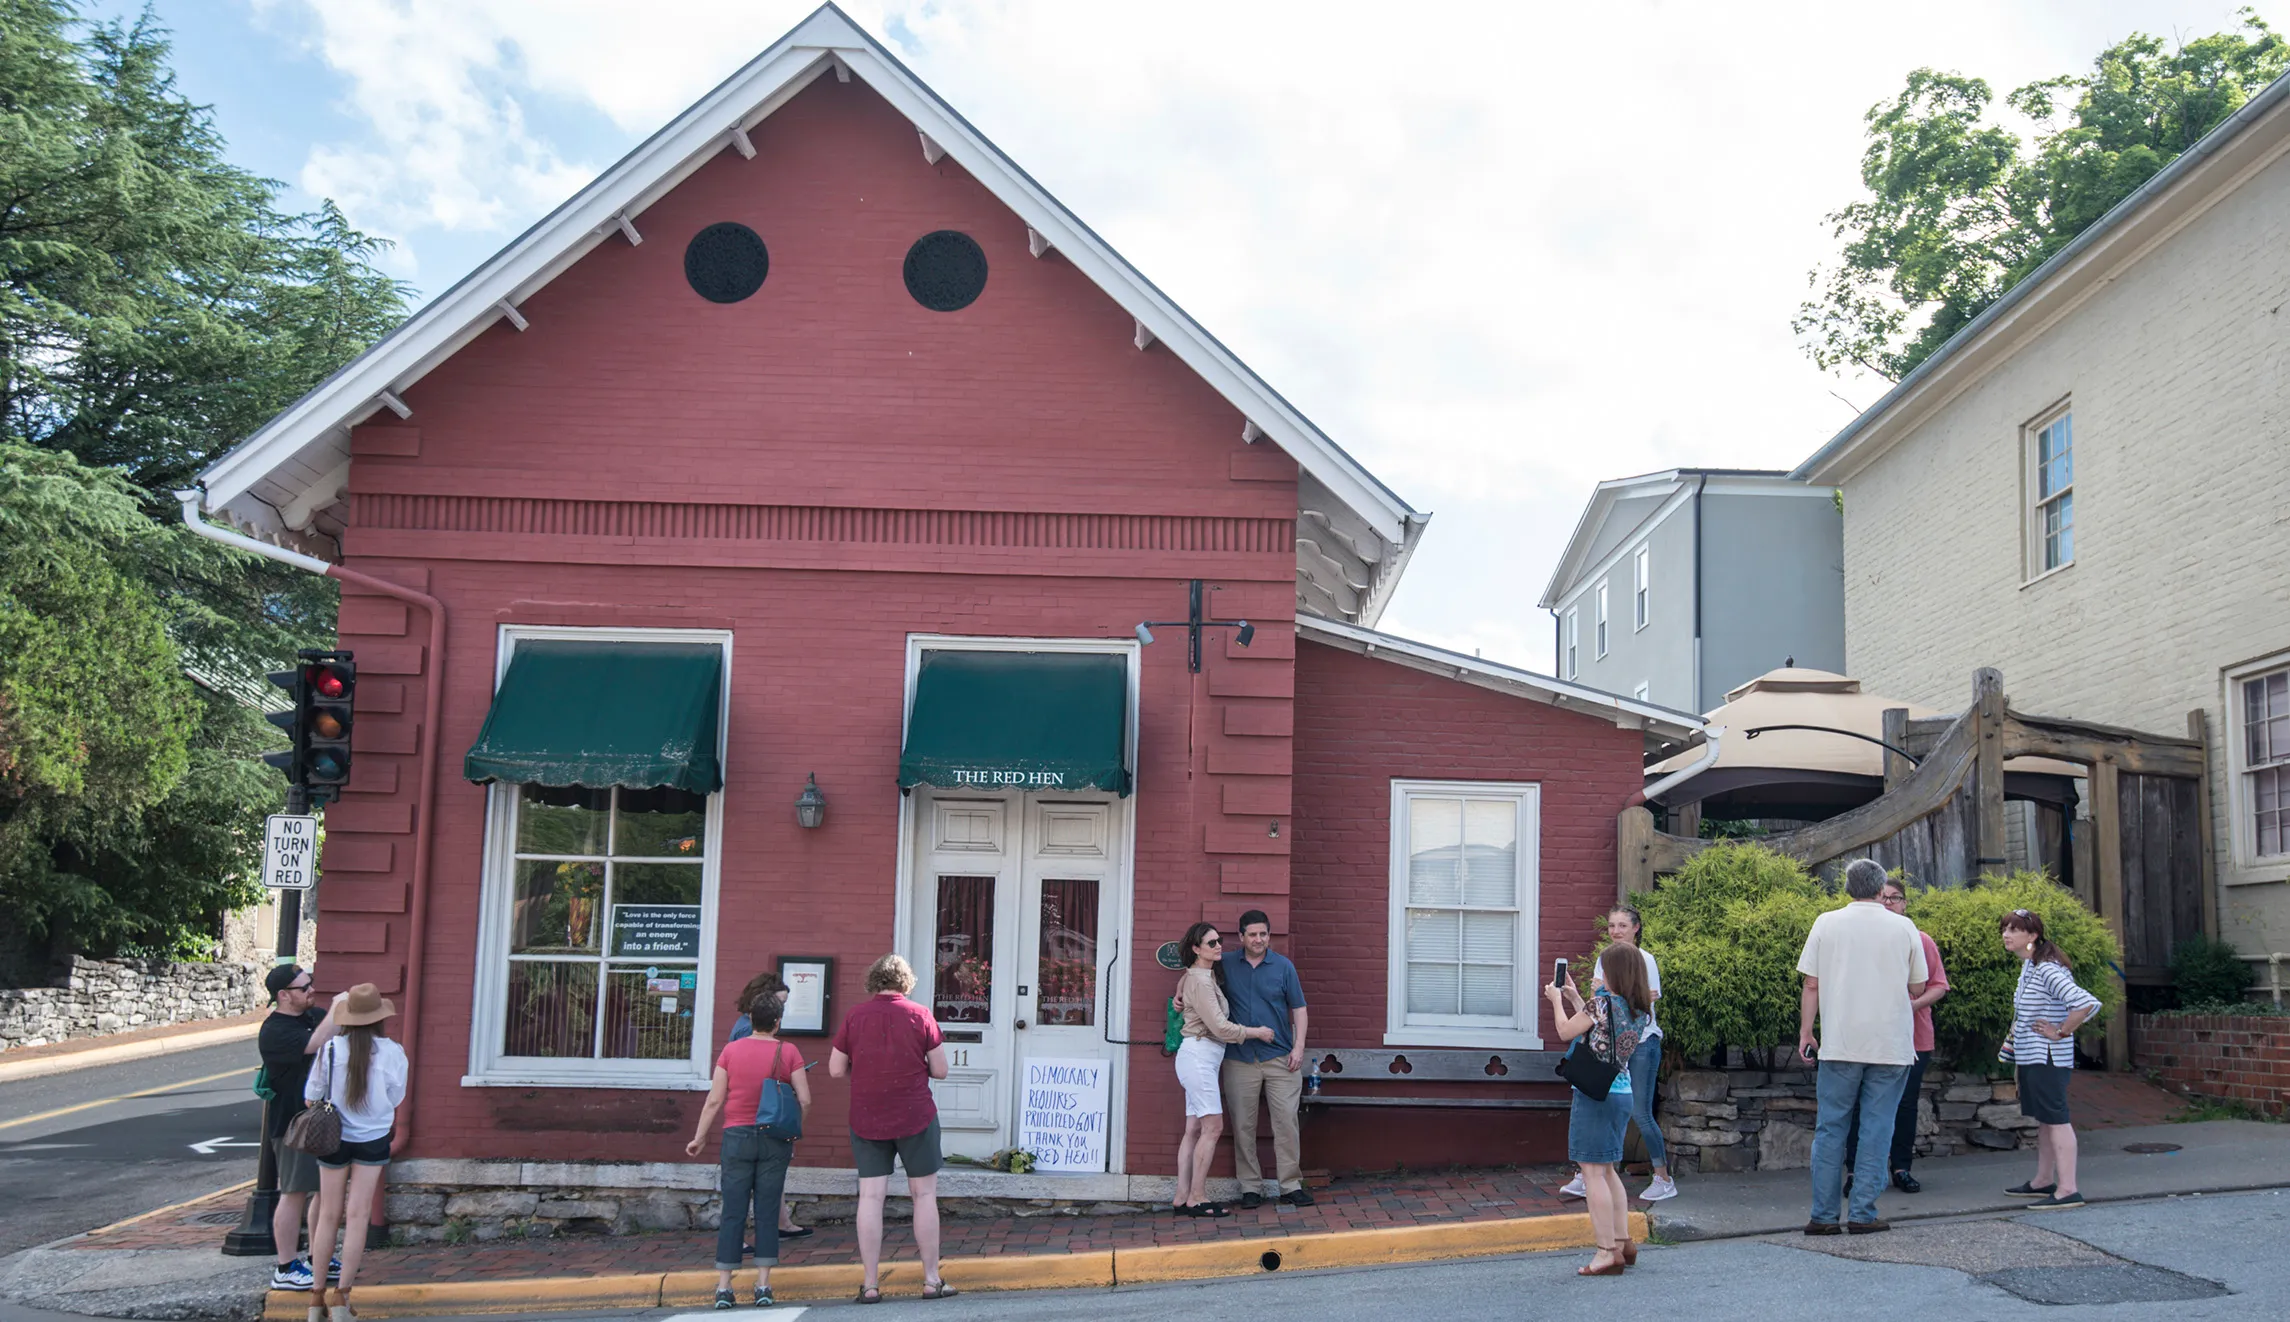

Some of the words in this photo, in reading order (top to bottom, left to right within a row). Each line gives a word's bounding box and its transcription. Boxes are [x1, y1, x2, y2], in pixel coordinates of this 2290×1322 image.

[953, 770, 988, 783] THE
[992, 771, 1025, 784] RED
[1028, 772, 1064, 785] HEN
[283, 820, 303, 834] NO
[274, 836, 309, 851] TURN
[280, 853, 299, 867] ON
[275, 869, 302, 884] RED
[662, 912, 678, 920] only
[649, 932, 679, 940] enemy
[623, 941, 642, 950] into
[644, 943, 651, 951] a
[952, 1049, 969, 1067] 11
[1030, 1065, 1098, 1089] DEMOCRACY
[1028, 1088, 1080, 1111] REQUIRES
[1025, 1110, 1075, 1129] PRINCIPLED
[1075, 1111, 1106, 1133] GOV'T
[1023, 1131, 1064, 1148] THANK
[1067, 1133, 1088, 1150] YOU
[1030, 1146, 1060, 1165] RED
[1064, 1148, 1098, 1167] HEN!!
